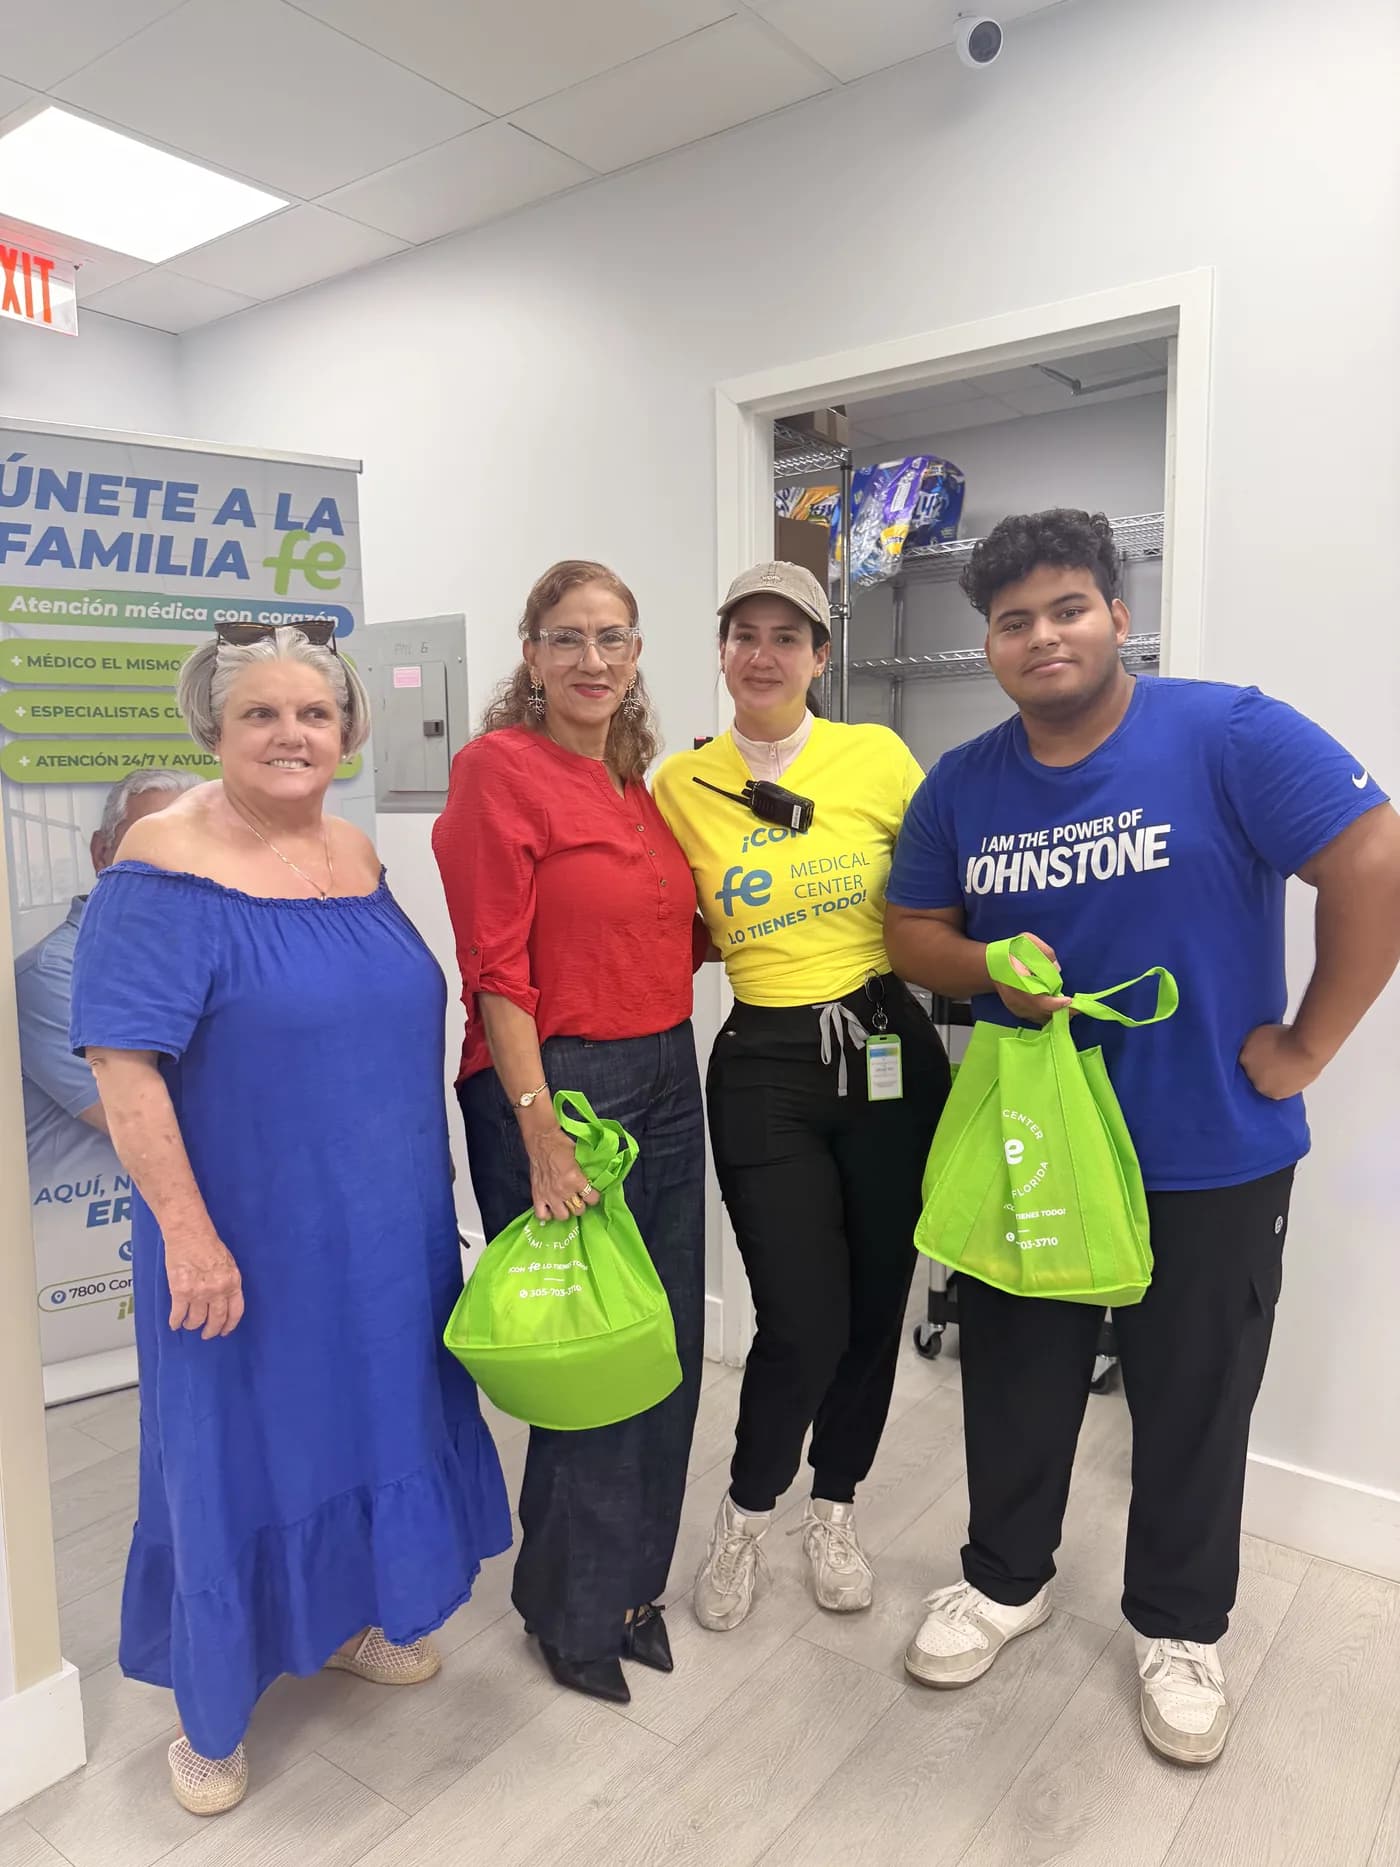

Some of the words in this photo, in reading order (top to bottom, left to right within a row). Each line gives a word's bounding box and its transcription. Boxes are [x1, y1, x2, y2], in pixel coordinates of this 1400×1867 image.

[0, 452, 199, 523] ÚNETE
[212, 488, 256, 528] A
[274, 492, 344, 536] LA
[0, 521, 250, 580] FAMILIA
[262, 529, 346, 596] fe
[8, 595, 118, 617] Atención
[125, 602, 208, 621] médica
[213, 609, 253, 623] con
[27, 653, 97, 669] MÉDICO
[102, 657, 122, 670] EL
[126, 658, 181, 672] MISMO
[31, 706, 159, 719] ESPECIALISTAS
[36, 752, 119, 767] ATENCIÓN
[122, 755, 155, 767] 24/7
[158, 755, 169, 766] Y
[981, 837, 987, 853] I
[987, 835, 1014, 853] AM
[1018, 830, 1050, 849] THE
[1053, 816, 1114, 844] POWER
[1118, 808, 1144, 829] OF
[790, 852, 871, 879] MEDICAL
[964, 824, 1171, 895] JOHNSTONE
[715, 866, 773, 917] fe
[794, 874, 864, 899] CENTER
[728, 929, 746, 945] LO
[747, 909, 807, 940] TIENES
[812, 889, 867, 917] TODO!
[1002, 1109, 1044, 1140] CENTER
[1004, 1138, 1025, 1165] e
[33, 1174, 105, 1205] AQUÍ,
[1011, 1161, 1049, 1199] FLORIDA
[86, 1196, 132, 1228] ER
[523, 1225, 543, 1249] MIAMI
[1016, 1236, 1059, 1250] 03-3710
[69, 1282, 106, 1299] 7800
